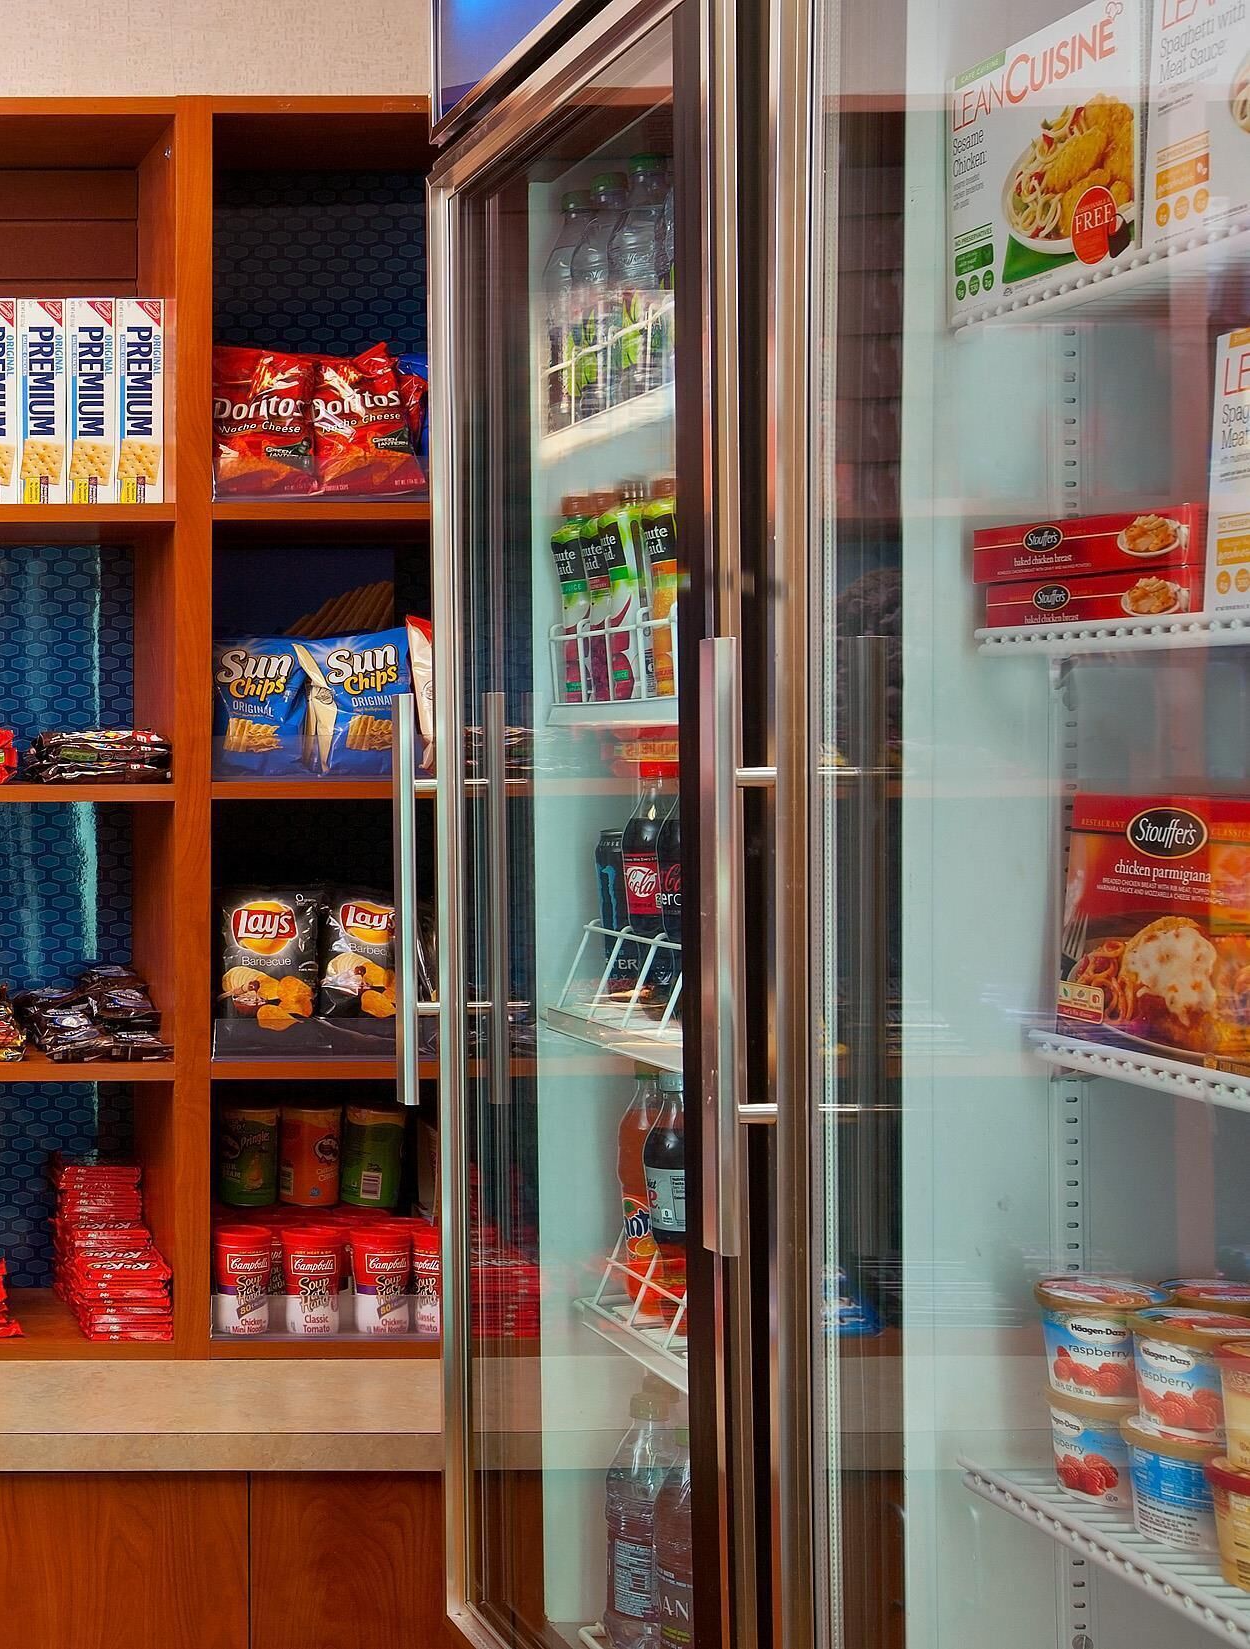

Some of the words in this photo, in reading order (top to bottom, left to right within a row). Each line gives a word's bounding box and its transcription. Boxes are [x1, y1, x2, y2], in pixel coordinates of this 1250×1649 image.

[1160, 17, 1215, 58] Spaghetti
[1158, 55, 1186, 84] Meat
[1190, 38, 1226, 68] Sauce
[953, 129, 984, 156] Sesame
[952, 151, 987, 178] Chicken
[1075, 202, 1114, 234] FREE
[29, 327, 55, 436] PREMIUM
[79, 327, 105, 436] PREMIUM
[127, 327, 153, 436] PREMIUM
[214, 395, 302, 420] Doritos
[220, 423, 256, 433] Nacho
[261, 421, 301, 433] Cheese
[362, 413, 401, 424] Cheese
[600, 534, 616, 546] ute
[644, 526, 668, 541] nute
[1027, 530, 1058, 546] Stouffer's
[581, 545, 602, 558] nute
[1014, 555, 1031, 566] baked
[1032, 554, 1054, 565] chicken
[1055, 553, 1072, 563] breast
[1035, 588, 1066, 605] Stouffer's
[1024, 614, 1040, 624] baked
[1041, 613, 1063, 623] chicken
[1063, 612, 1079, 622] breast
[216, 650, 293, 684] Sun
[327, 645, 398, 684] Sun
[344, 666, 398, 694] Chips
[230, 678, 287, 701] Chips
[232, 700, 274, 717] ORIGINAL
[351, 696, 392, 707] ORIGINA
[1081, 818, 1125, 828] RESTAURANT
[1135, 818, 1197, 848] Stouffer's
[1115, 859, 1150, 876] chicken
[1152, 865, 1211, 886] parmigiana
[237, 911, 292, 938] Lay's
[349, 943, 390, 955] Barbec
[241, 956, 291, 966] Barbecue
[240, 1131, 270, 1148] Pringles
[230, 1257, 268, 1271] Campbell's
[293, 1258, 335, 1272] Campbell's
[367, 1257, 407, 1272] Campbell's
[236, 1275, 262, 1292] Soup
[299, 1277, 330, 1294] Soup
[375, 1275, 402, 1292] Soup
[300, 1295, 332, 1313] Hand
[240, 1318, 263, 1327] Chicken
[304, 1314, 329, 1323] Classic
[381, 1318, 403, 1327] Chicken
[303, 1325, 331, 1333] Tomato
[1071, 1323, 1127, 1338] Häagen-Dazs
[1068, 1344, 1129, 1359] raspberry
[1141, 1347, 1191, 1367] Häagen-Dazs
[1141, 1368, 1195, 1390] raspberry
